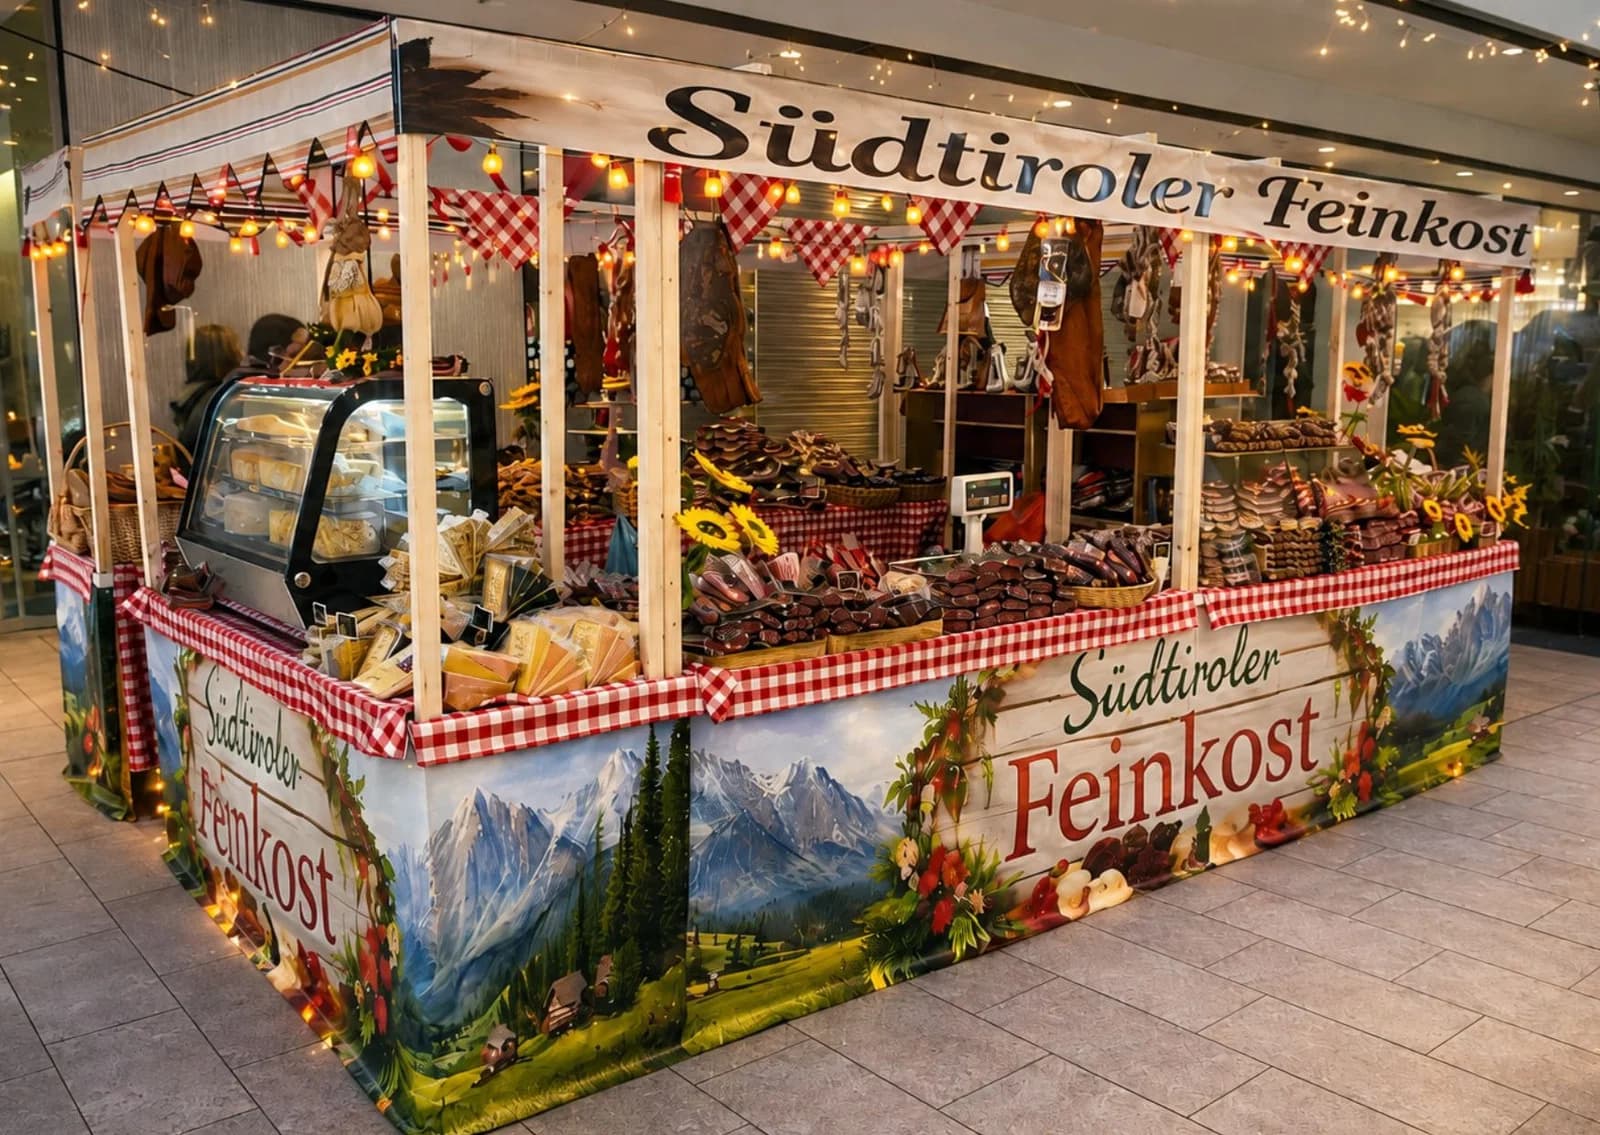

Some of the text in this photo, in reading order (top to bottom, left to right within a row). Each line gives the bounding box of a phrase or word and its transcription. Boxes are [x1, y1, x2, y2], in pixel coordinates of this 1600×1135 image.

[647, 86, 1534, 256] Südtiroler Feinkost
[205, 665, 302, 790] Südtiroler
[1064, 624, 1281, 735] Südtiroler
[198, 767, 336, 945] Feinkost
[1005, 697, 1320, 862] Feinkost
